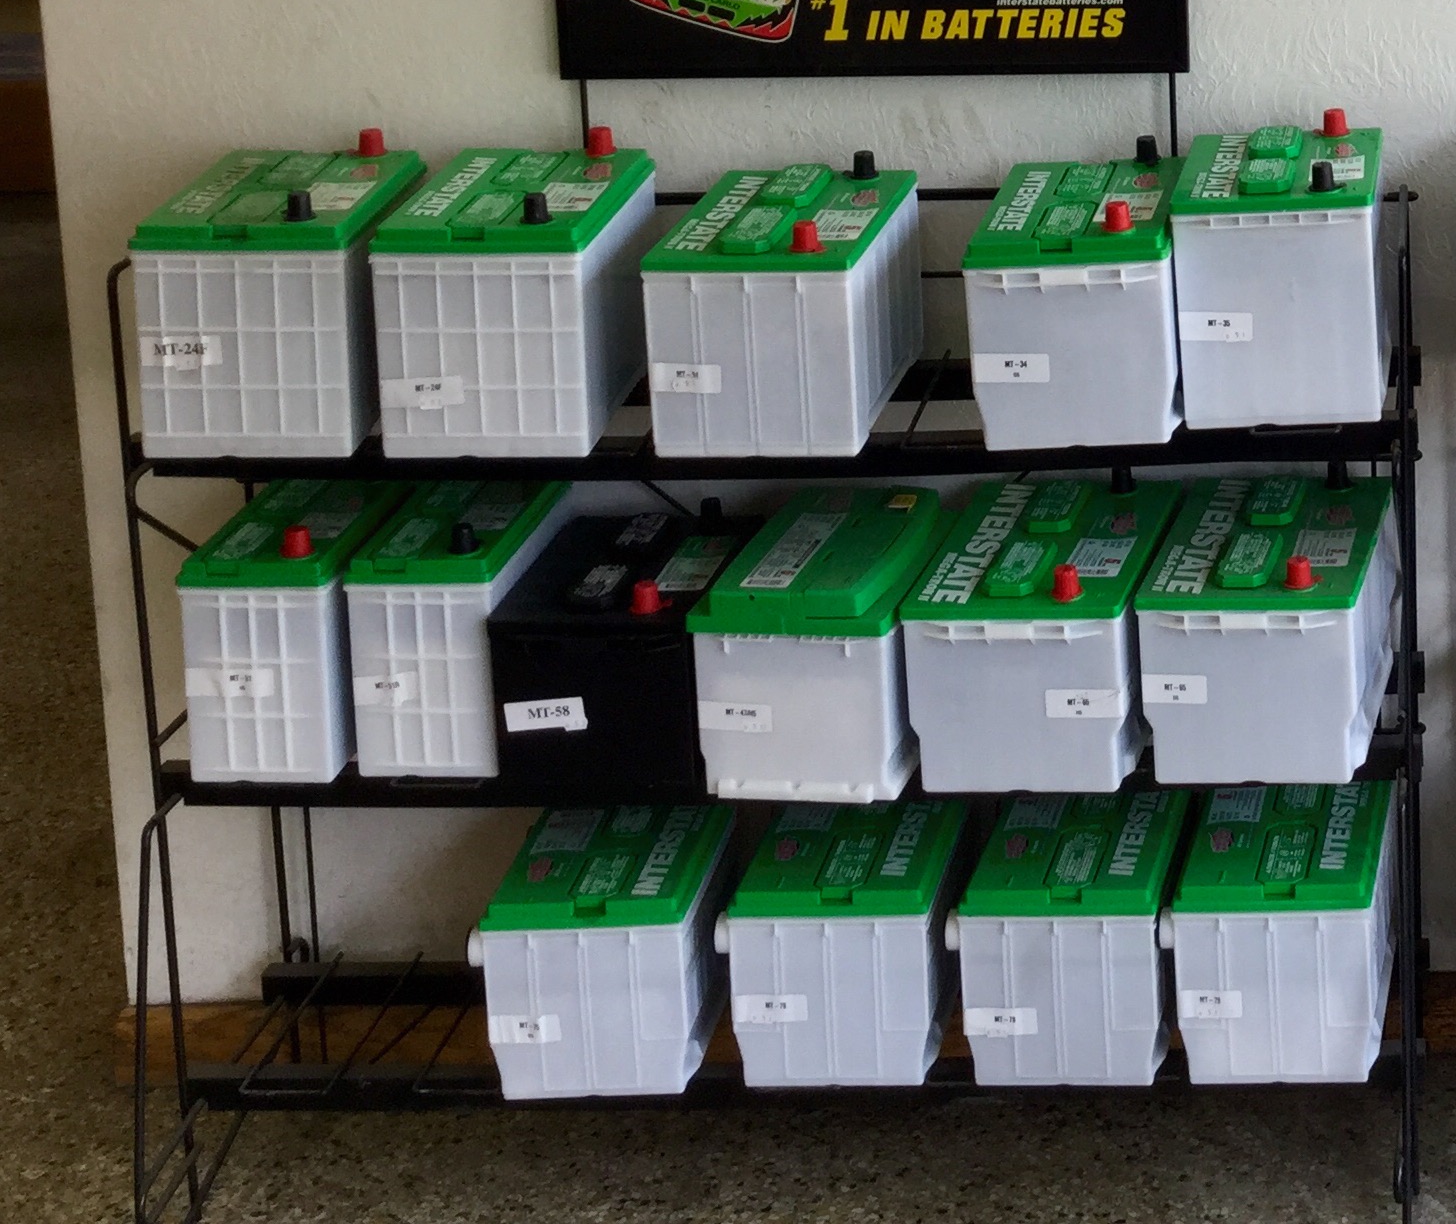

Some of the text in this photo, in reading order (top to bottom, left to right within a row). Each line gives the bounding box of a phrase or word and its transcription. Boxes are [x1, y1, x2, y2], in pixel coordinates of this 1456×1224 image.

[866, 10, 912, 40] IN
[921, 8, 1127, 39] BATTERIES
[1202, 135, 1248, 198] INTERSTATE
[675, 176, 768, 251] INTERSTATE
[997, 171, 1051, 231] INTERSTATE
[931, 483, 1037, 604] INTERSTATE
[1165, 479, 1250, 595] INTERSTATE
[527, 706, 571, 719] MT-58
